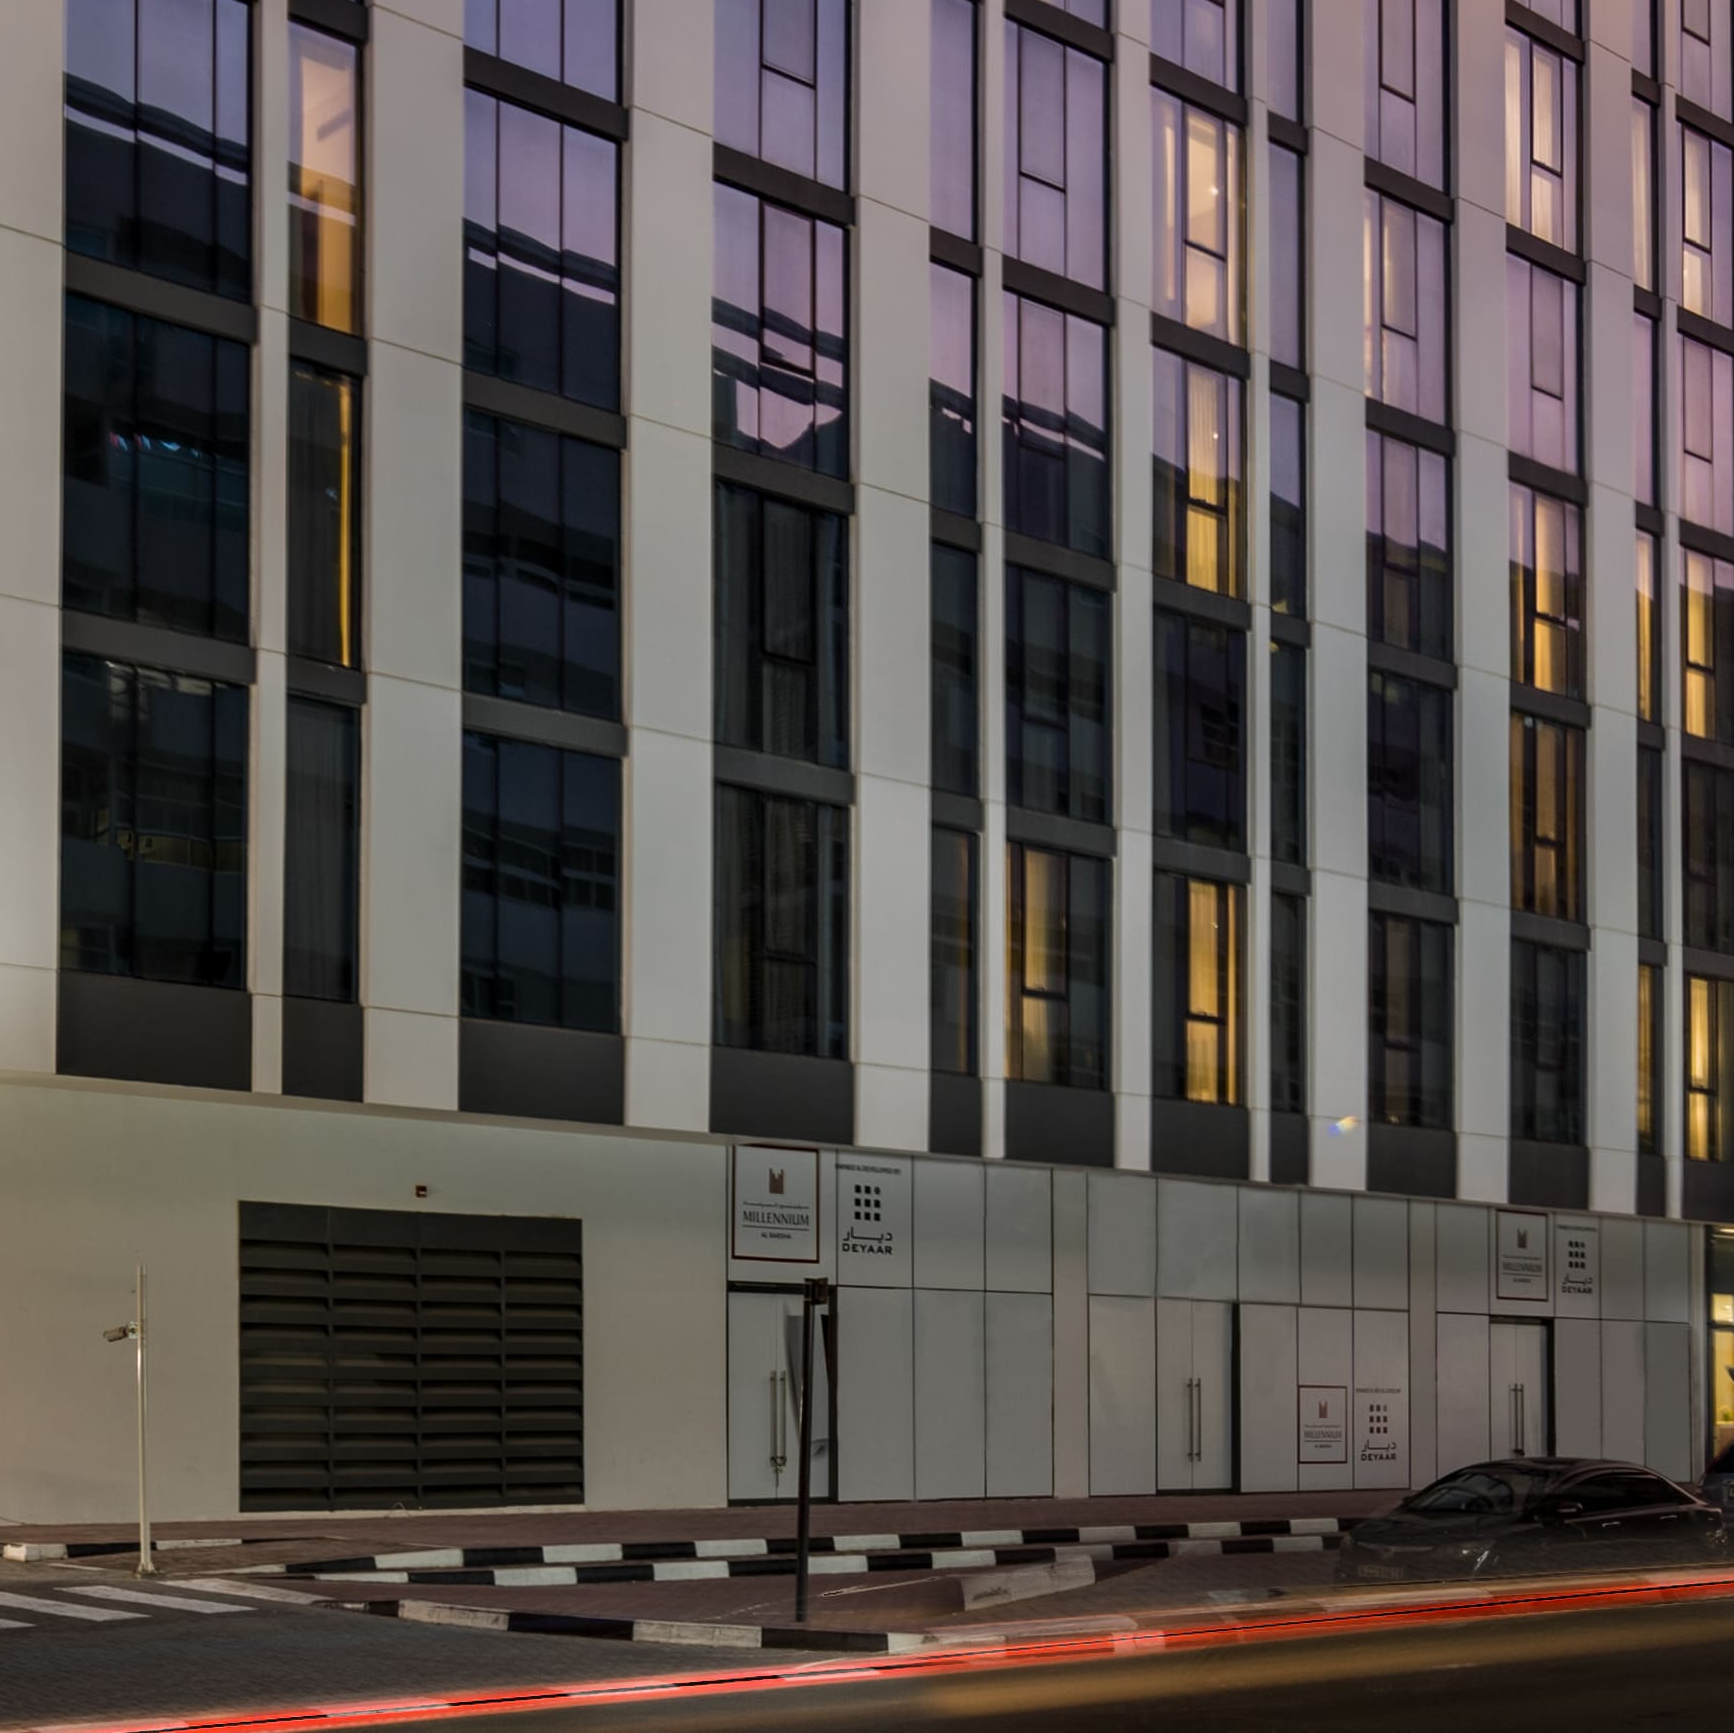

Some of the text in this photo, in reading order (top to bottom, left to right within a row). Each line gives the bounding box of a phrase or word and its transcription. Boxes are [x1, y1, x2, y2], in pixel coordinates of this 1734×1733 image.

[743, 1210, 809, 1226] MILLENNIUM
[843, 1226, 893, 1243] ديار
[842, 1243, 893, 1255] DEYAAR
[1360, 1453, 1396, 1462] DEYAAR
